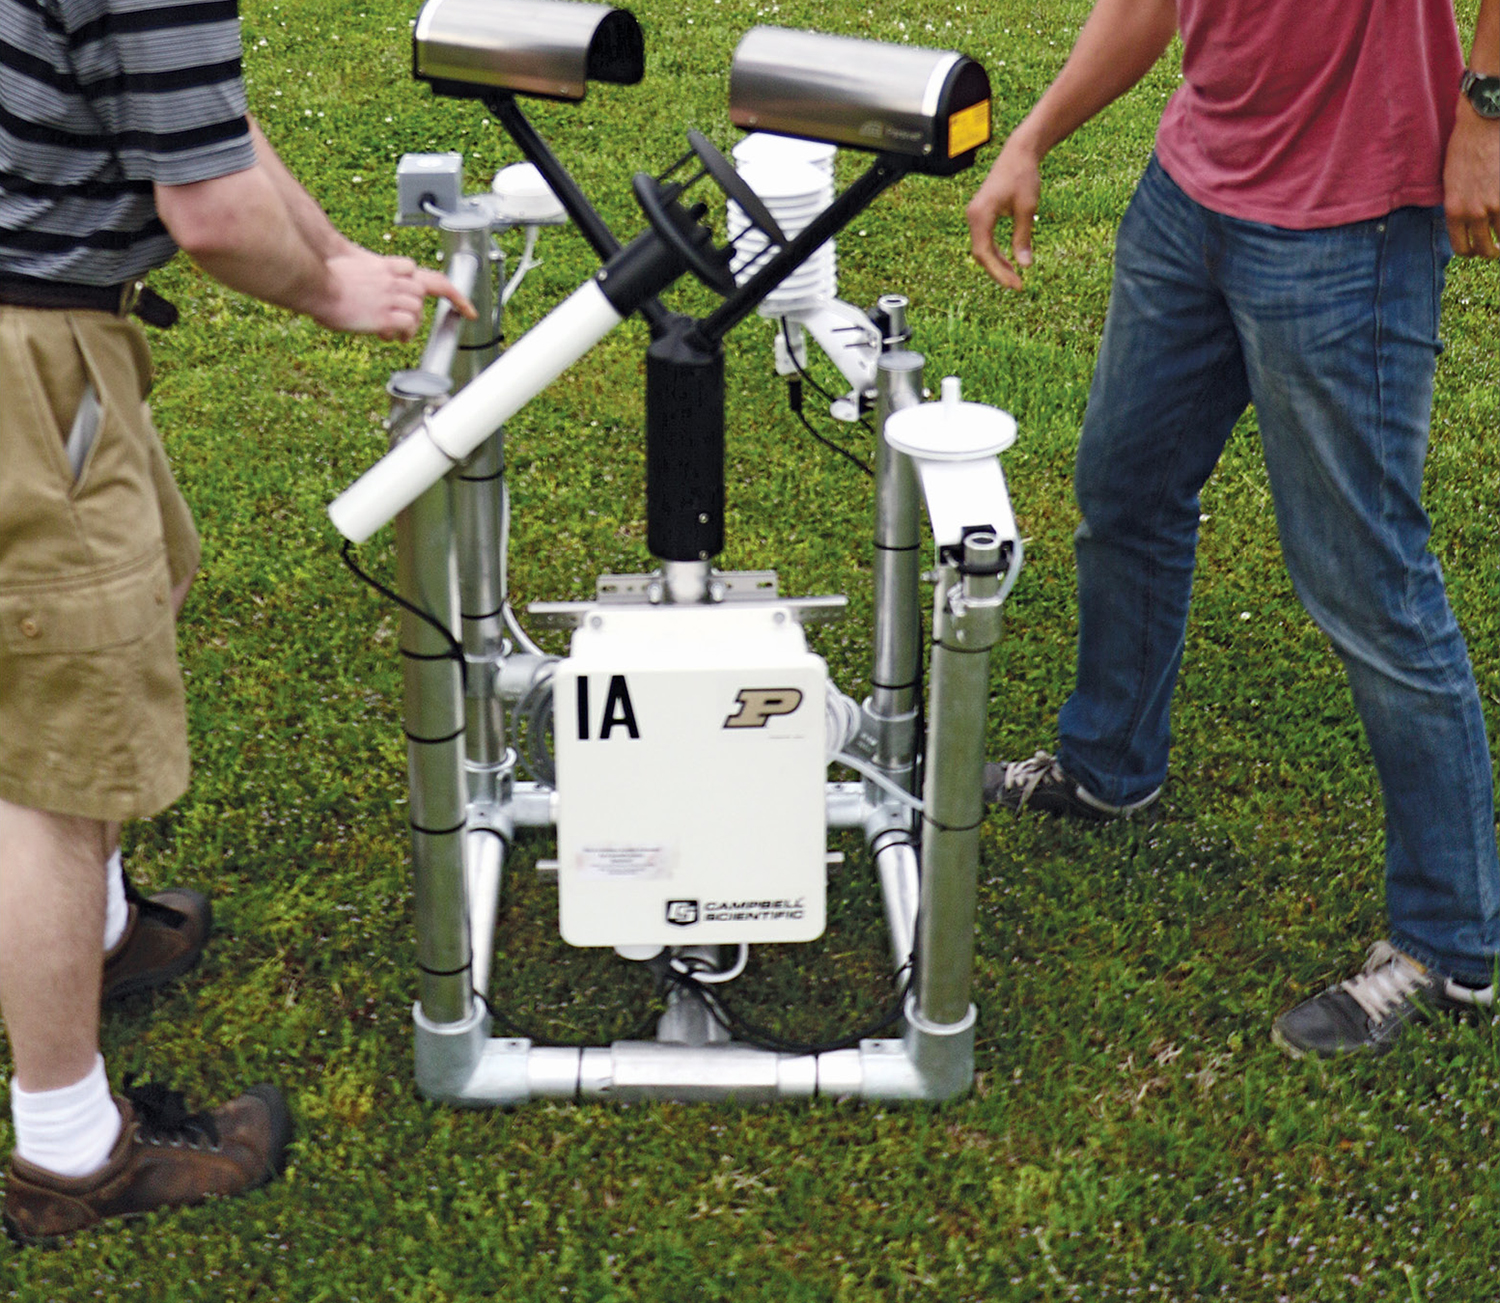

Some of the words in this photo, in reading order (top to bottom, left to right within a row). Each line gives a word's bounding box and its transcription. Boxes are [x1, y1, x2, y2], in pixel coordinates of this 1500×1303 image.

[723, 687, 804, 729] P
[704, 898, 804, 911] CAMPBELL
[704, 910, 803, 921] SCIENTIFIC
